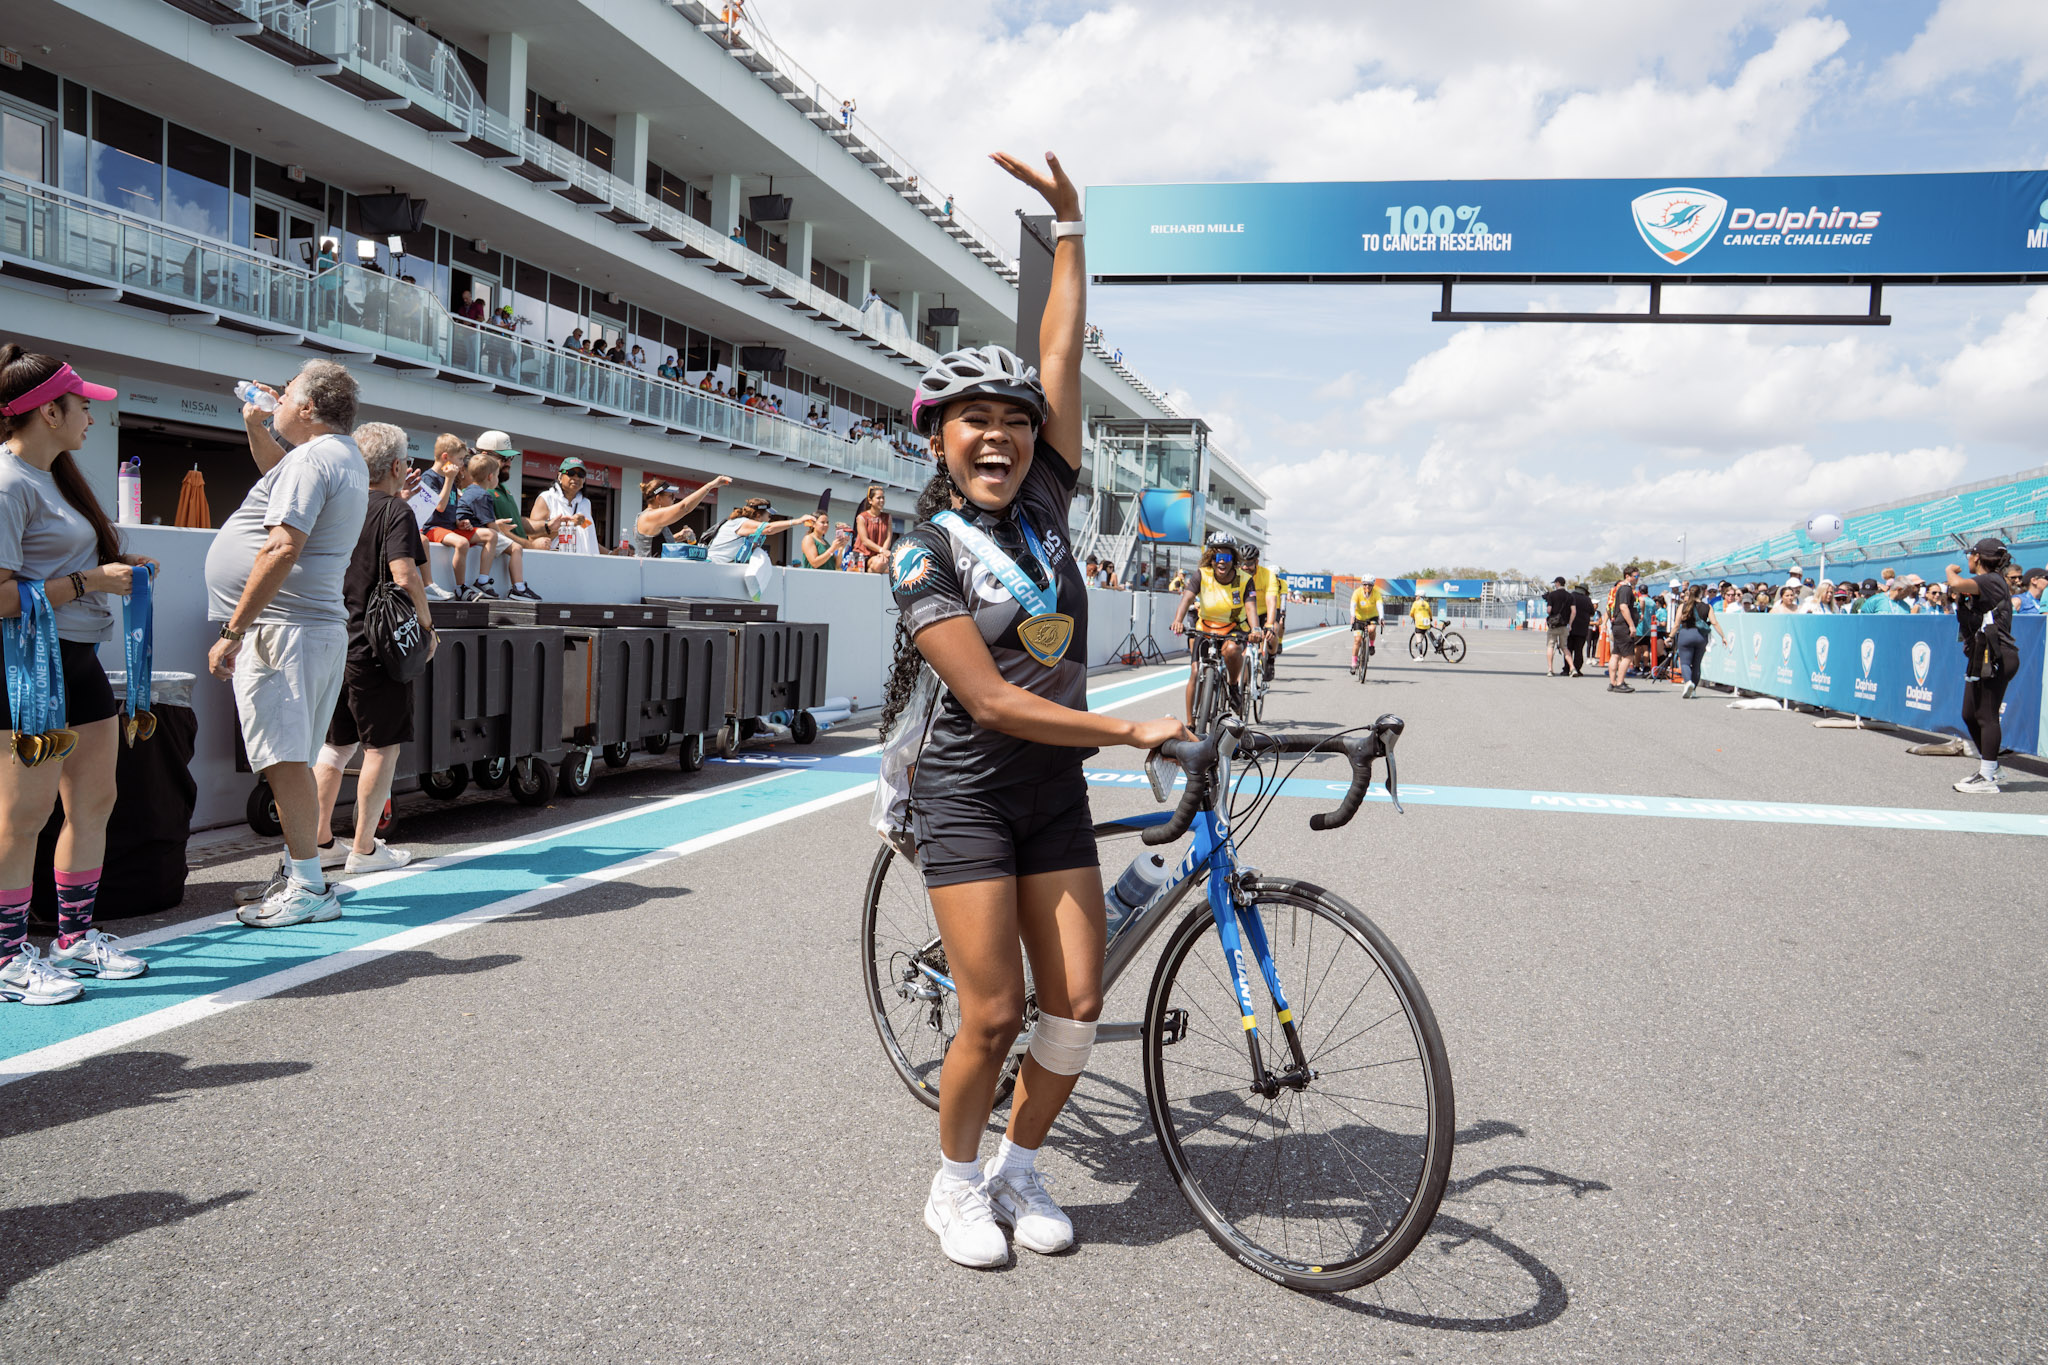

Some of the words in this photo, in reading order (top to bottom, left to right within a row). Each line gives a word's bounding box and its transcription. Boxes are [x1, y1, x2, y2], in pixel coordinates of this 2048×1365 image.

[1150, 223, 1205, 234] RICHARD
[1207, 223, 1245, 233] MILLE
[1384, 204, 1489, 237] 100%
[1727, 205, 1882, 235] Dolphins
[1362, 234, 1380, 252] TO
[1382, 233, 1436, 252] CANCER
[1439, 232, 1512, 252] RESEARCH
[1722, 234, 1781, 246] CANCER
[1783, 233, 1873, 246] CHALLENGE
[2027, 228, 2048, 249] MI
[181, 399, 218, 414] NISSAN
[131, 482, 141, 519] Skylar
[977, 545, 1008, 574] ONE
[1286, 575, 1325, 590] FIGHT.
[914, 602, 938, 616] PRIMAL
[36, 625, 46, 663] FIGHT.
[8, 665, 18, 688] ONE
[36, 665, 47, 688] ONE
[1530, 795, 1649, 811] NOW
[1664, 801, 1947, 825] DISMOUNT
[1233, 949, 1254, 1011] GIANT
[1238, 1254, 1282, 1281] BONTRAGER
